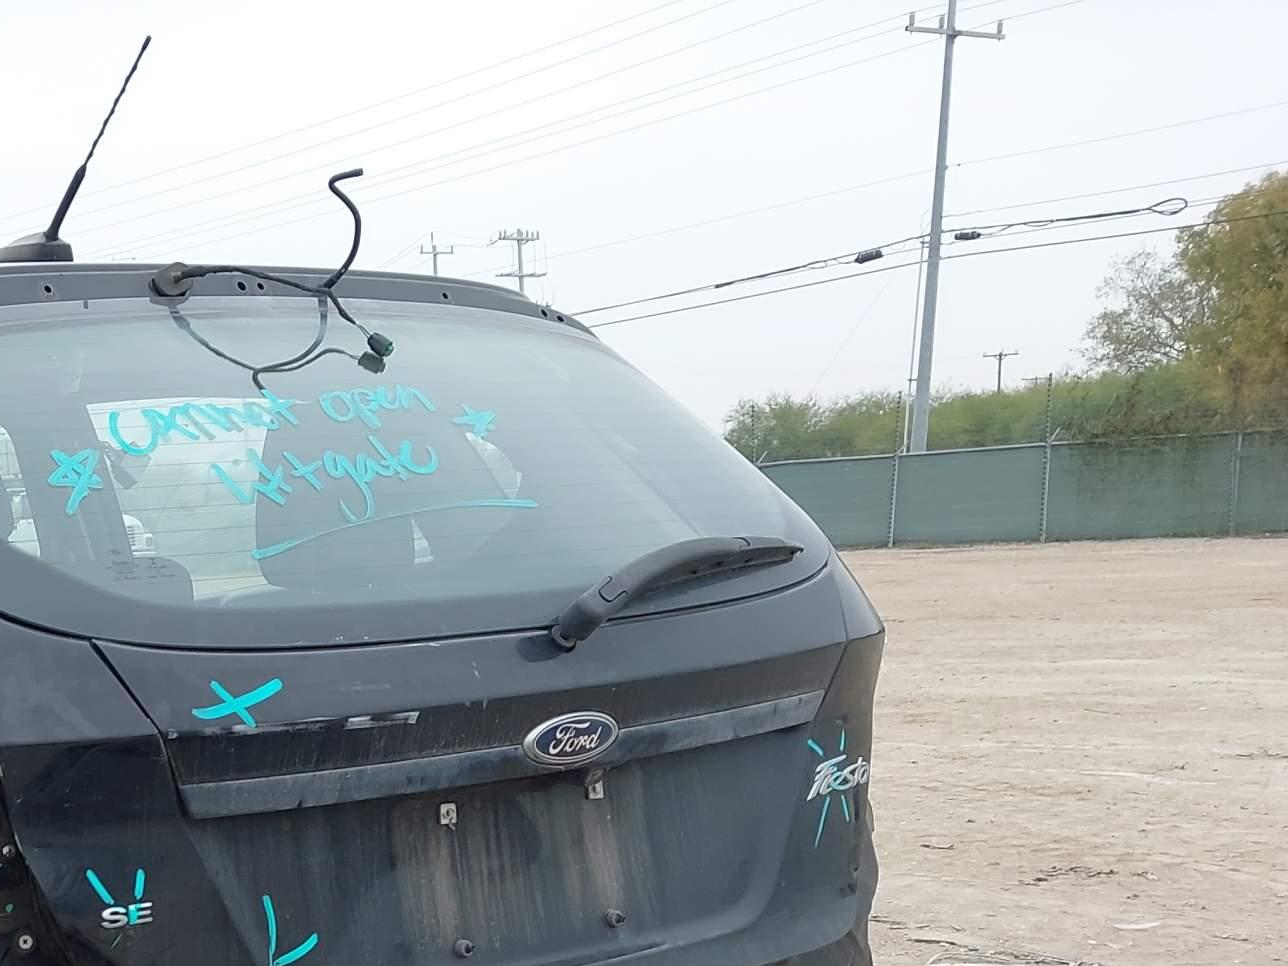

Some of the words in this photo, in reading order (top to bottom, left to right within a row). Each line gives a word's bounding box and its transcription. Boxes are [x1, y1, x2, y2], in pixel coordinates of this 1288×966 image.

[319, 385, 436, 429] open
[549, 721, 602, 755] Ford
[807, 754, 870, 801] Fiesta
[101, 902, 153, 929] SE
